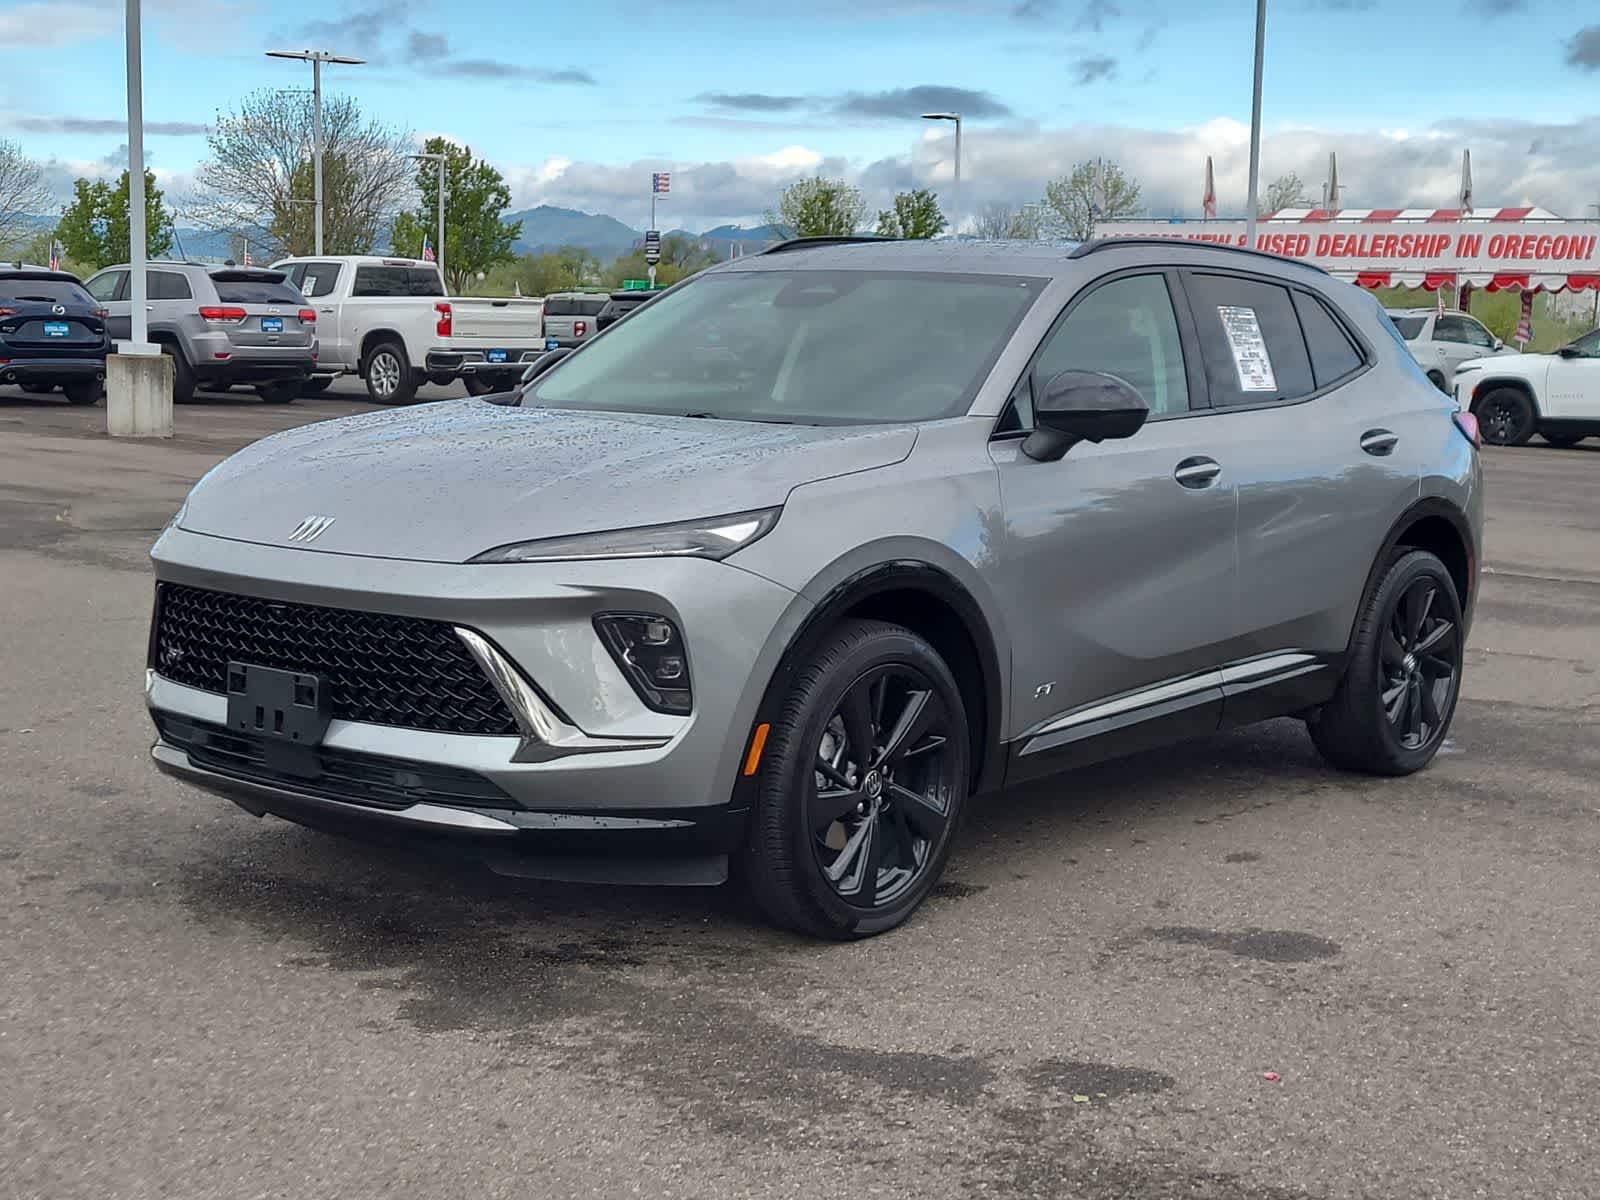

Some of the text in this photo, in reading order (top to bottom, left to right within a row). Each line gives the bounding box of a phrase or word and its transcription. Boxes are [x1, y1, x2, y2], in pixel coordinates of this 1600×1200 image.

[1256, 234, 1311, 257] USED
[1316, 234, 1451, 259] DEALERSHIP
[1456, 234, 1483, 259] IN
[1488, 234, 1597, 261] OREGON!
